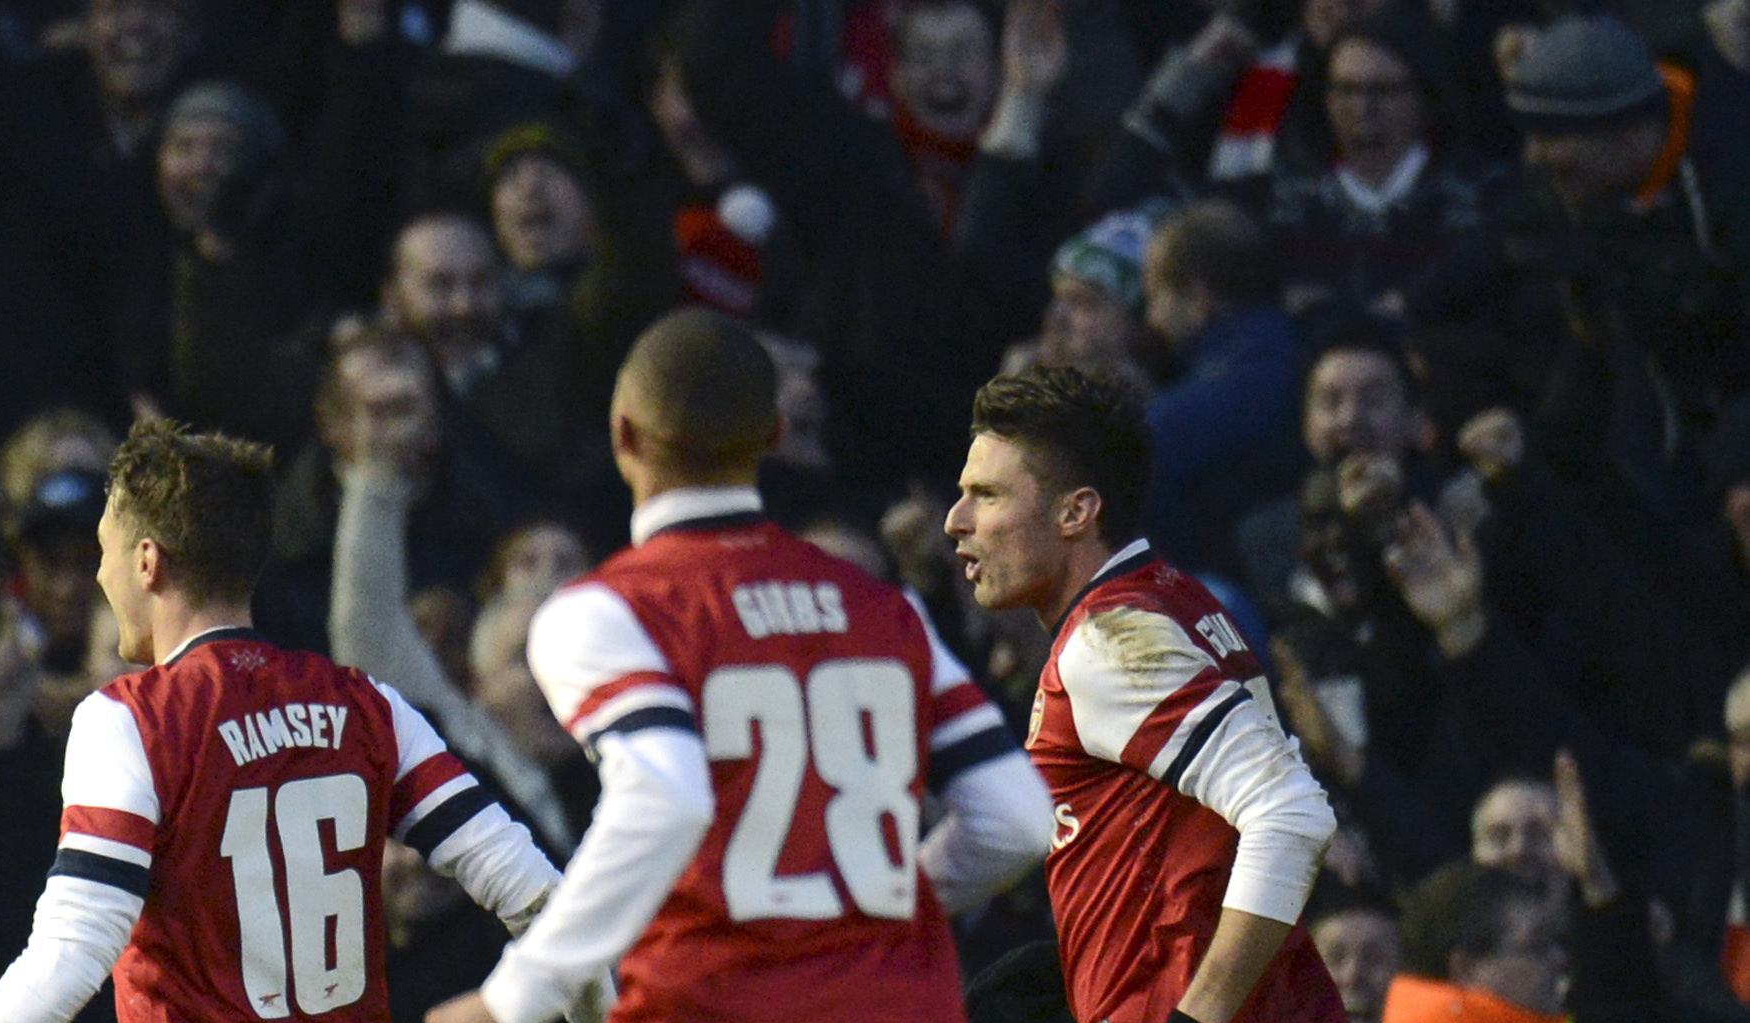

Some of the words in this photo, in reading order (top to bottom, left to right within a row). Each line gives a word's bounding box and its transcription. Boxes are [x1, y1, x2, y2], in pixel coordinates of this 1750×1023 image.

[218, 703, 348, 767] RAMSEY
[701, 658, 921, 924] 28
[219, 773, 368, 1020] 16
